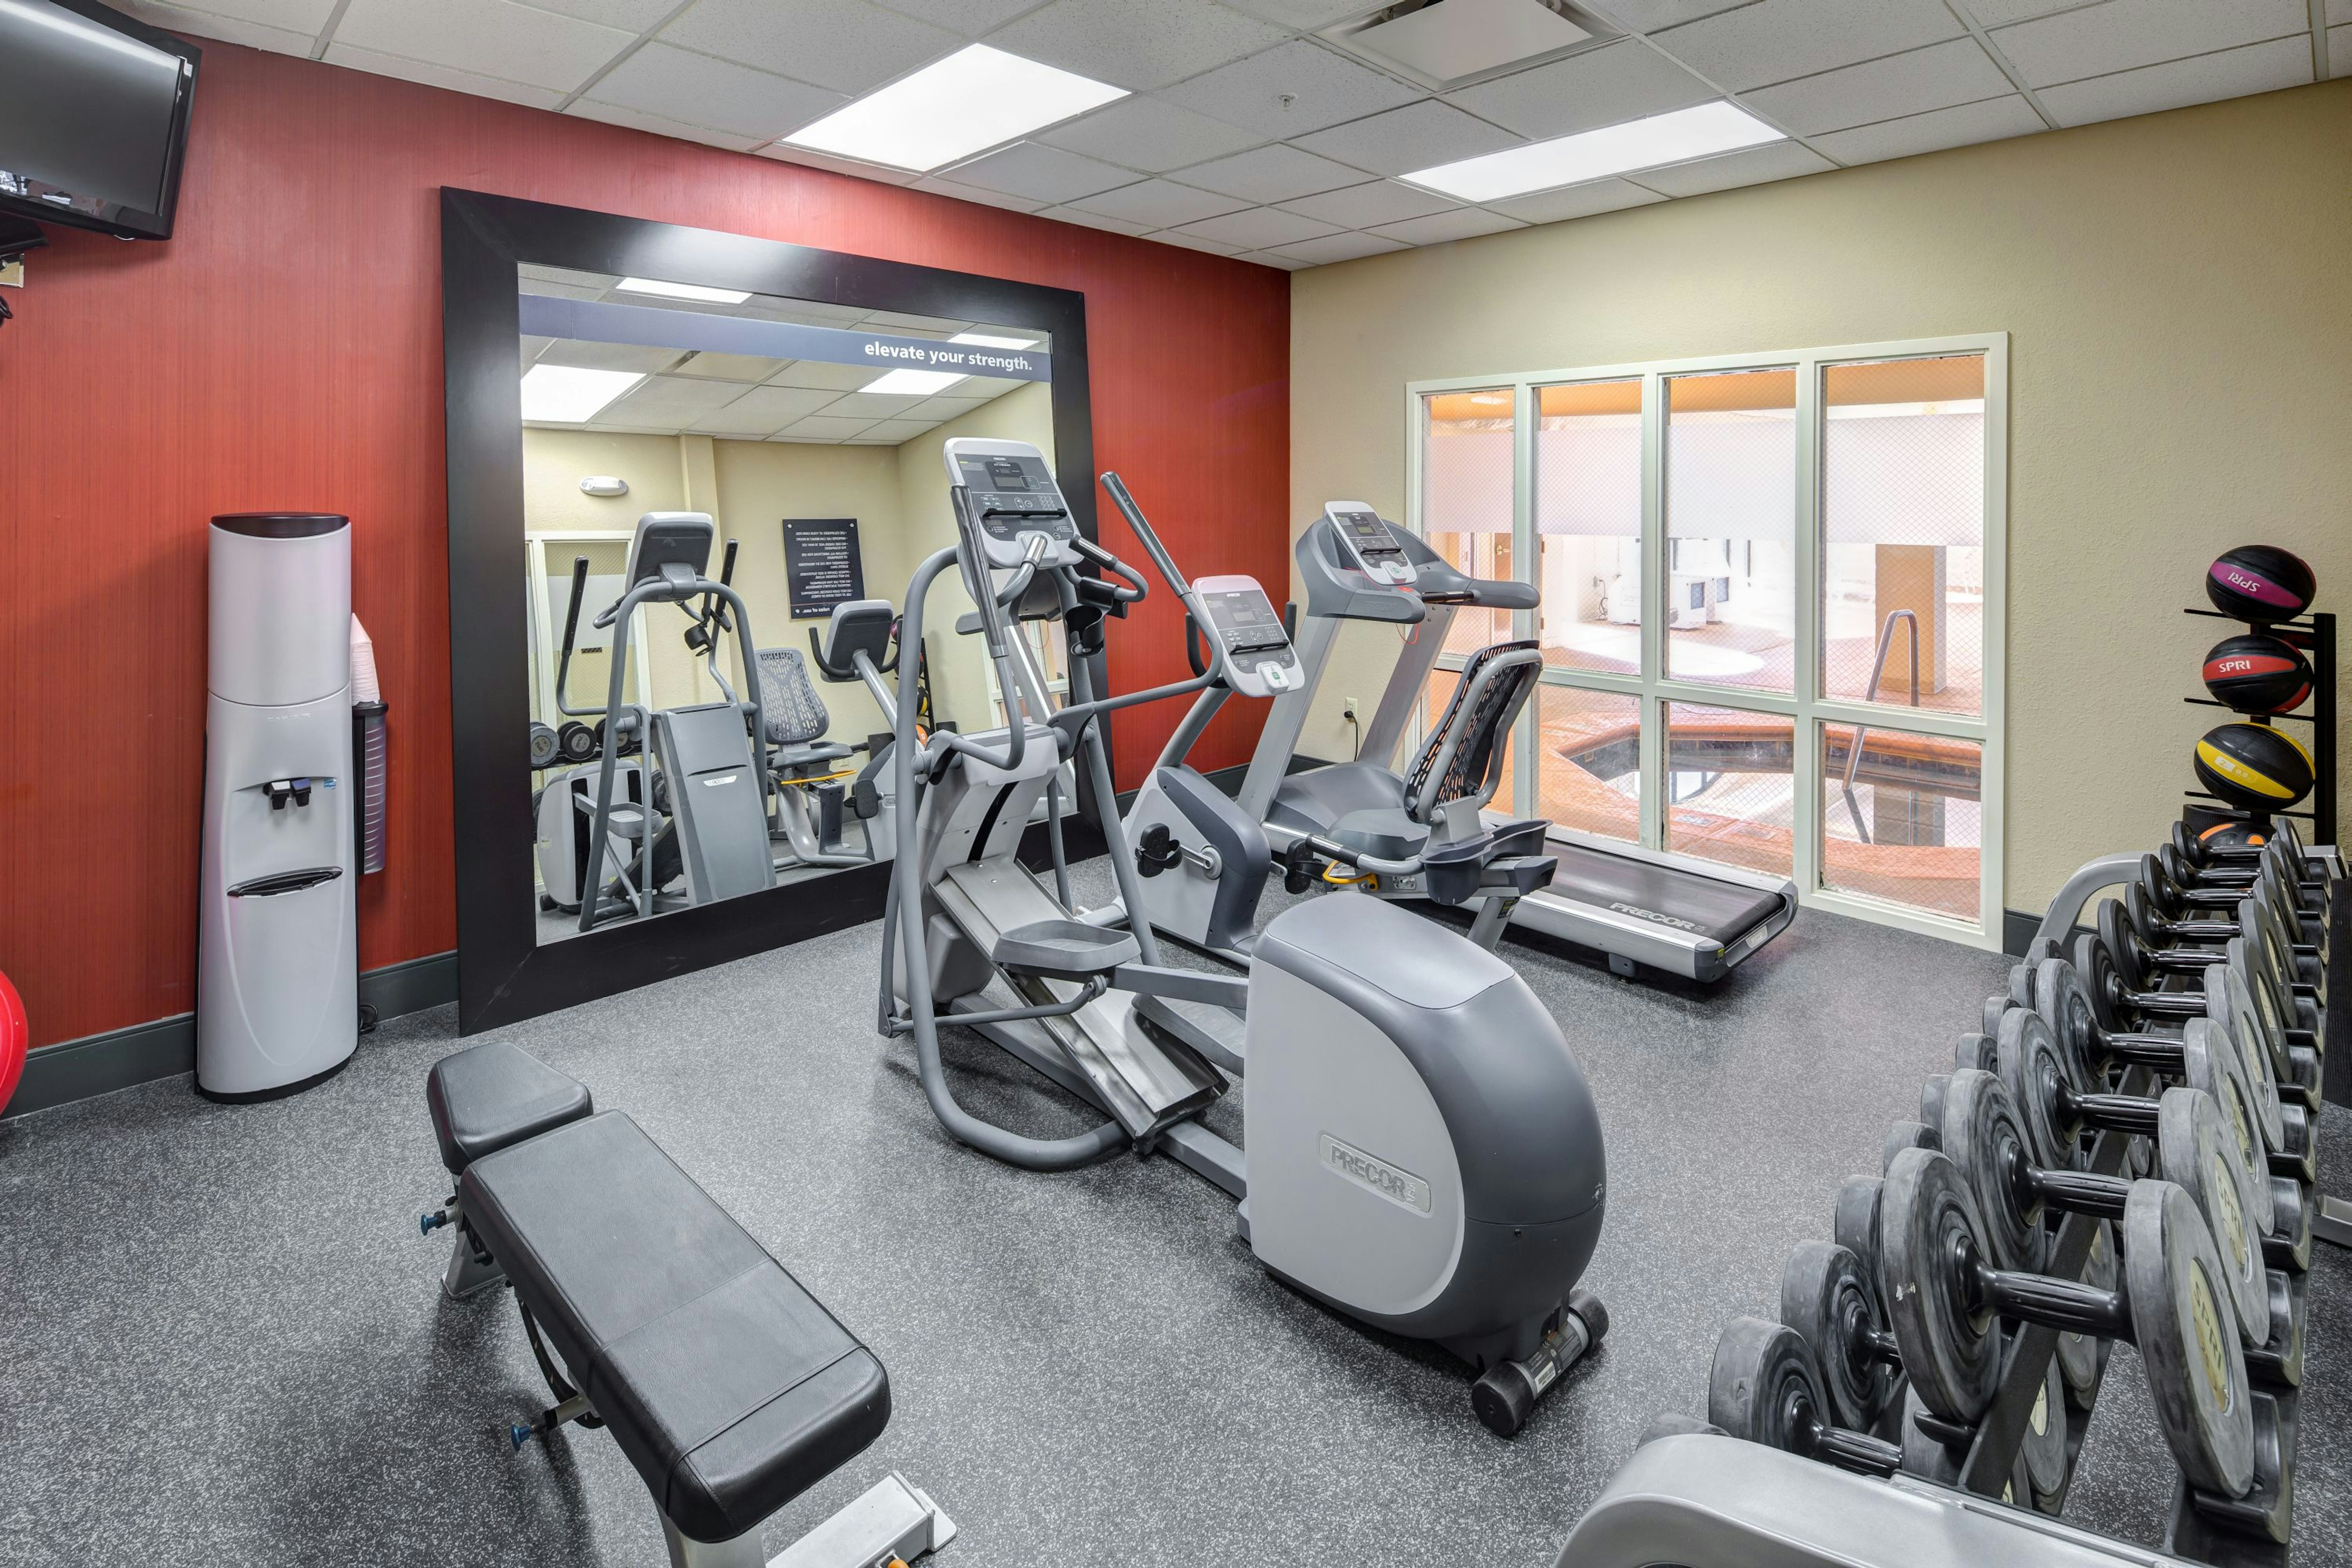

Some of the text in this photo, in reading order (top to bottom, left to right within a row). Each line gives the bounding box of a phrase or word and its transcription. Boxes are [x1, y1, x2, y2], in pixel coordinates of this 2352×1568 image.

[865, 341, 1032, 372] elevate your strength.
[2227, 572, 2261, 592] SPRI
[2219, 660, 2251, 673] SPRI
[1610, 902, 1695, 930] PRECOR
[1330, 1144, 1406, 1199] PRECOR
[2217, 1175, 2242, 1240] SPRI
[2193, 1281, 2221, 1371] SPRI
